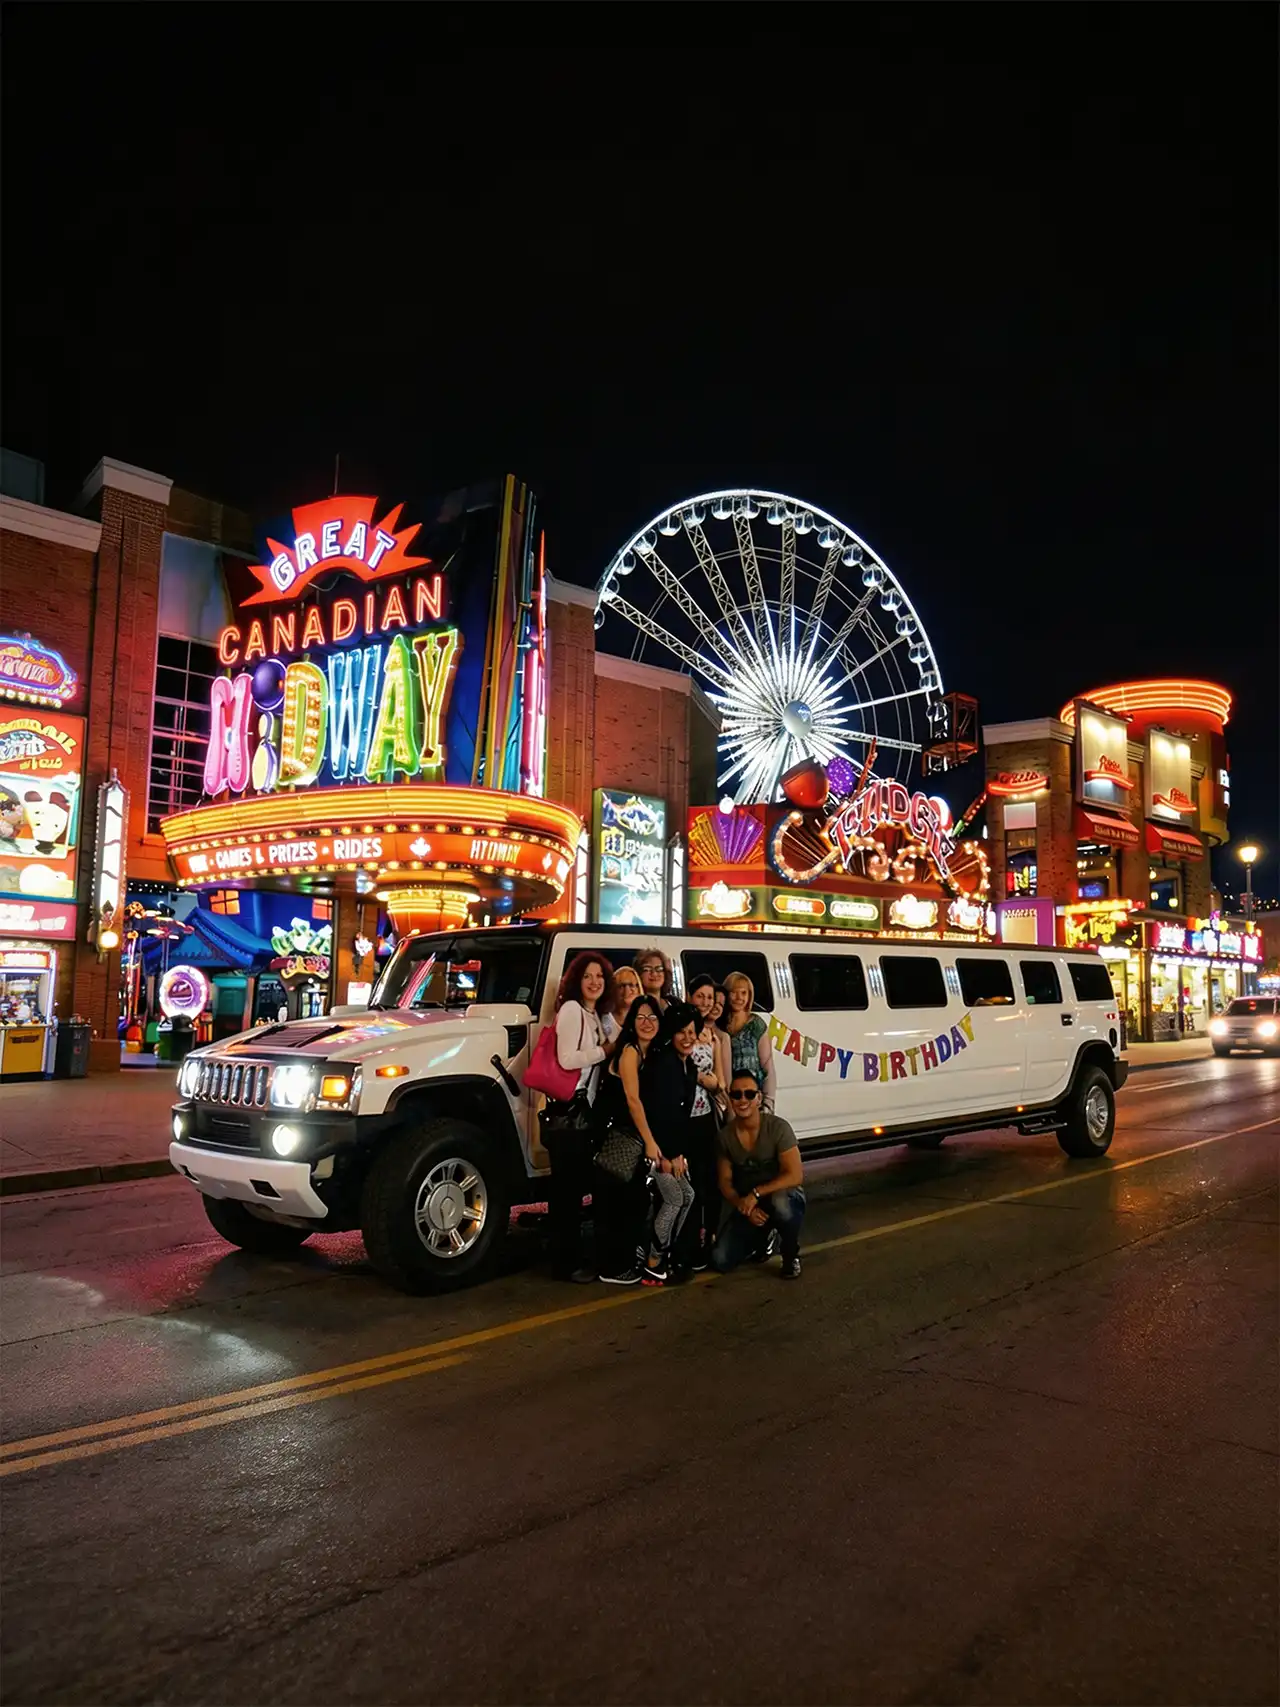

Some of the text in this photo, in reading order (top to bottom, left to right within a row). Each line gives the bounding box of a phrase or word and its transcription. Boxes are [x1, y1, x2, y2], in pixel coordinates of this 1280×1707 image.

[269, 520, 395, 593] GREAT
[218, 575, 445, 665] CANADIAN
[268, 841, 318, 864] PRIZES
[333, 837, 383, 860] RIDES
[768, 1014, 975, 1082] HAPPY BIRTHDAY
